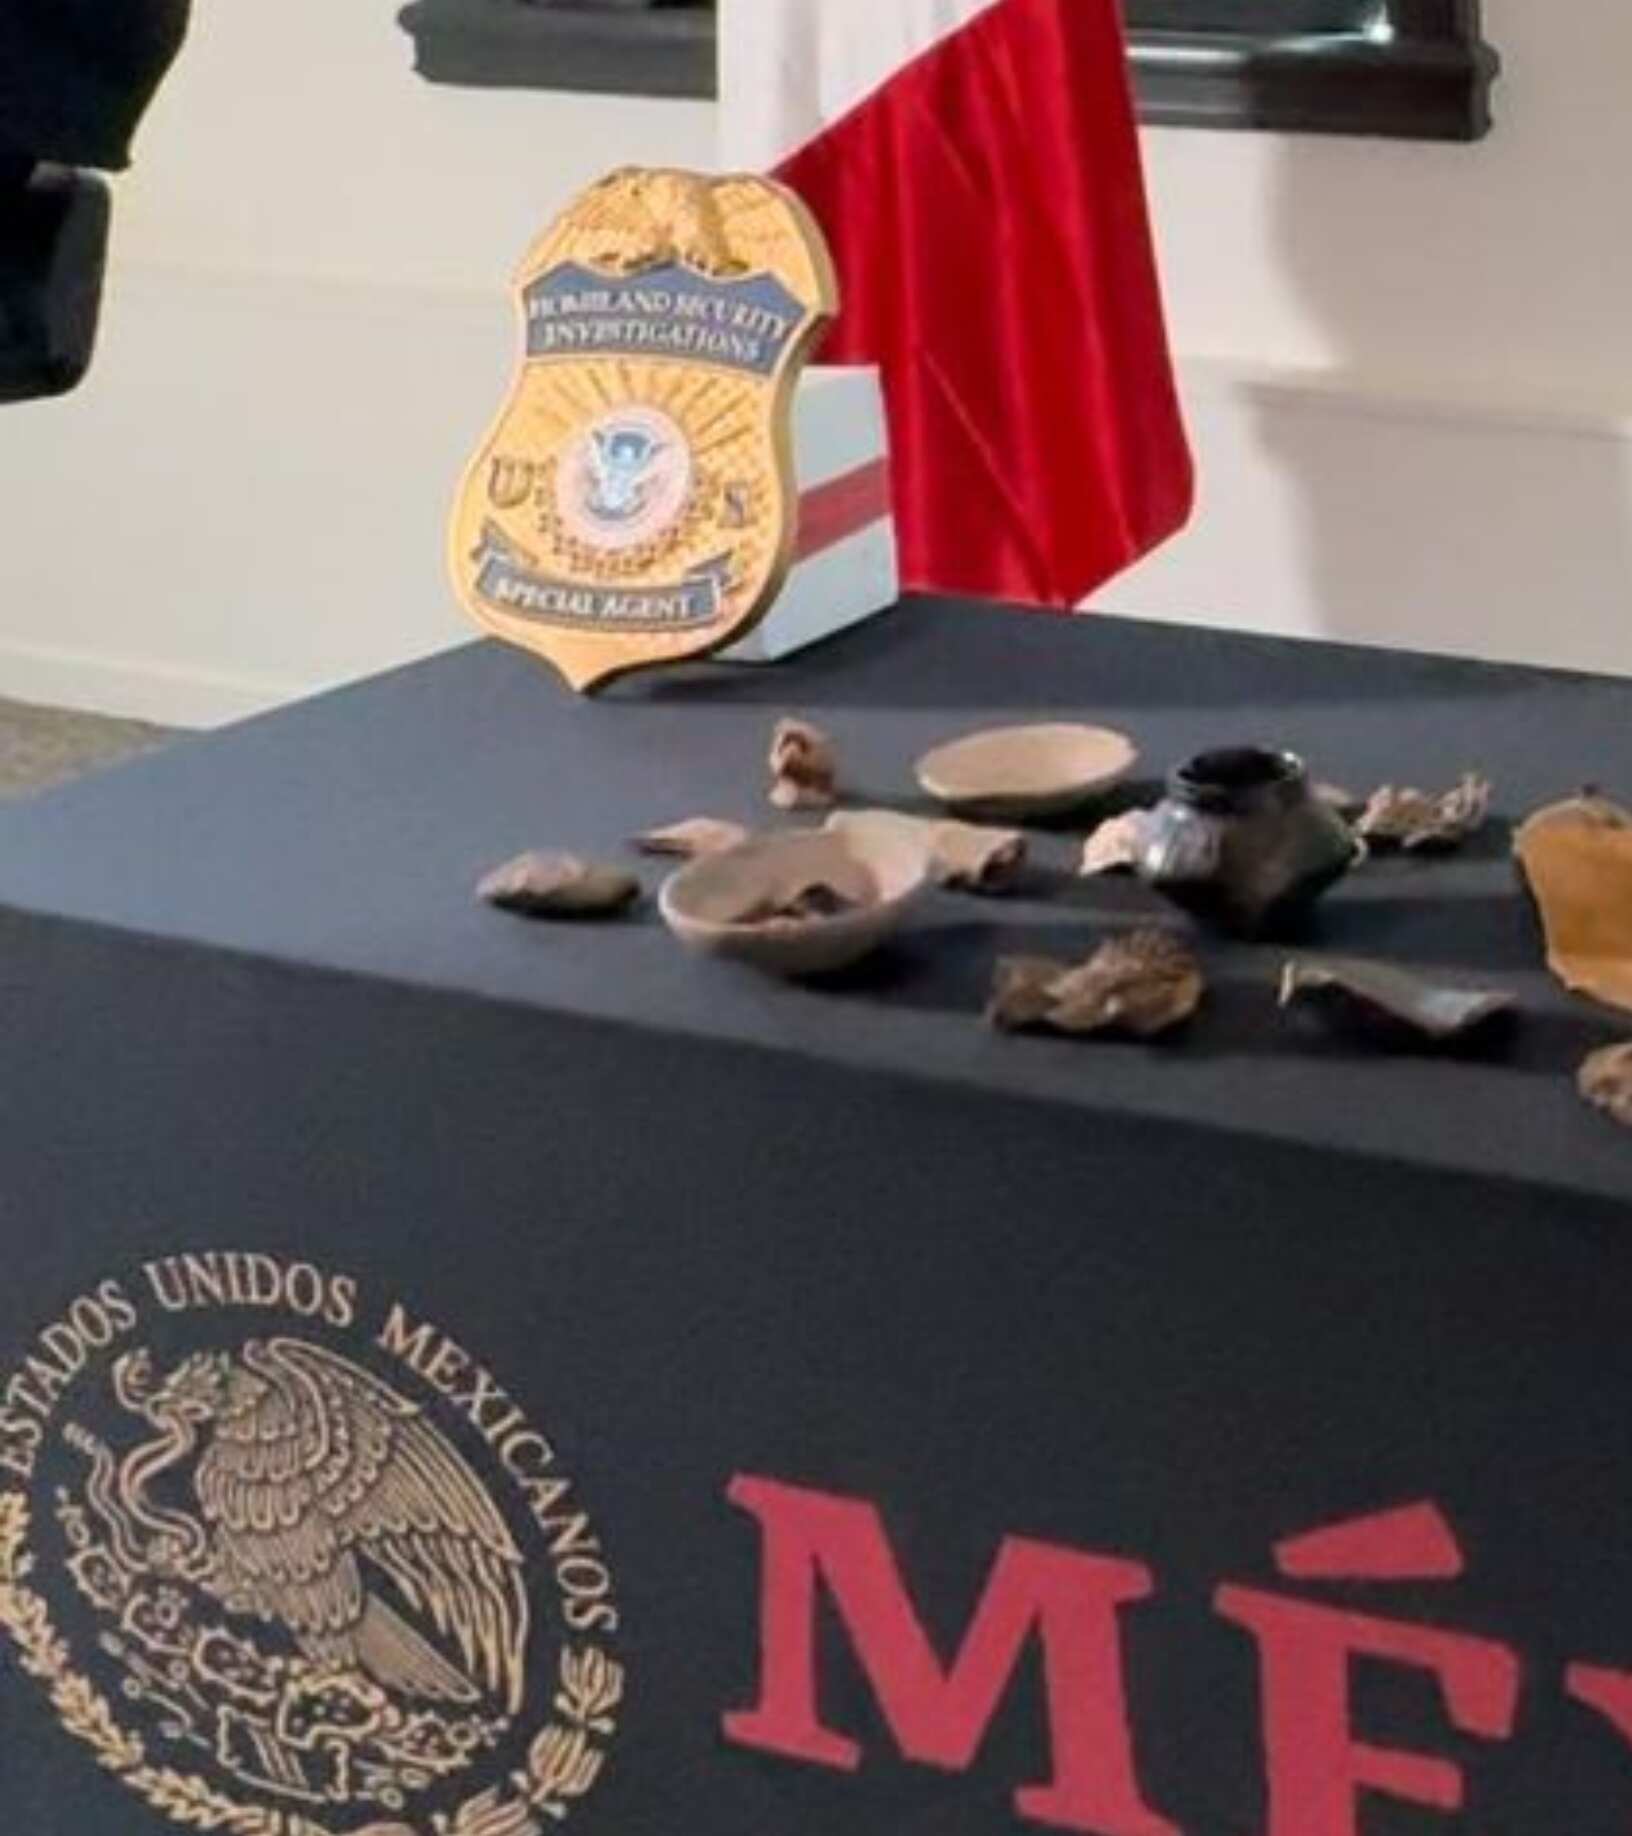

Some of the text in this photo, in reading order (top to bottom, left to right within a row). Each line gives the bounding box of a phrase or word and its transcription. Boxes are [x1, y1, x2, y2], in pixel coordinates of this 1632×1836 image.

[528, 291, 789, 340] HOMELAND SECURITY
[544, 318, 762, 359] INVESTIGATIONS
[496, 579, 696, 619] SPECIAL AGENT
[0, 1252, 618, 1632] ESTADOS UNIDOS MEXICANOS
